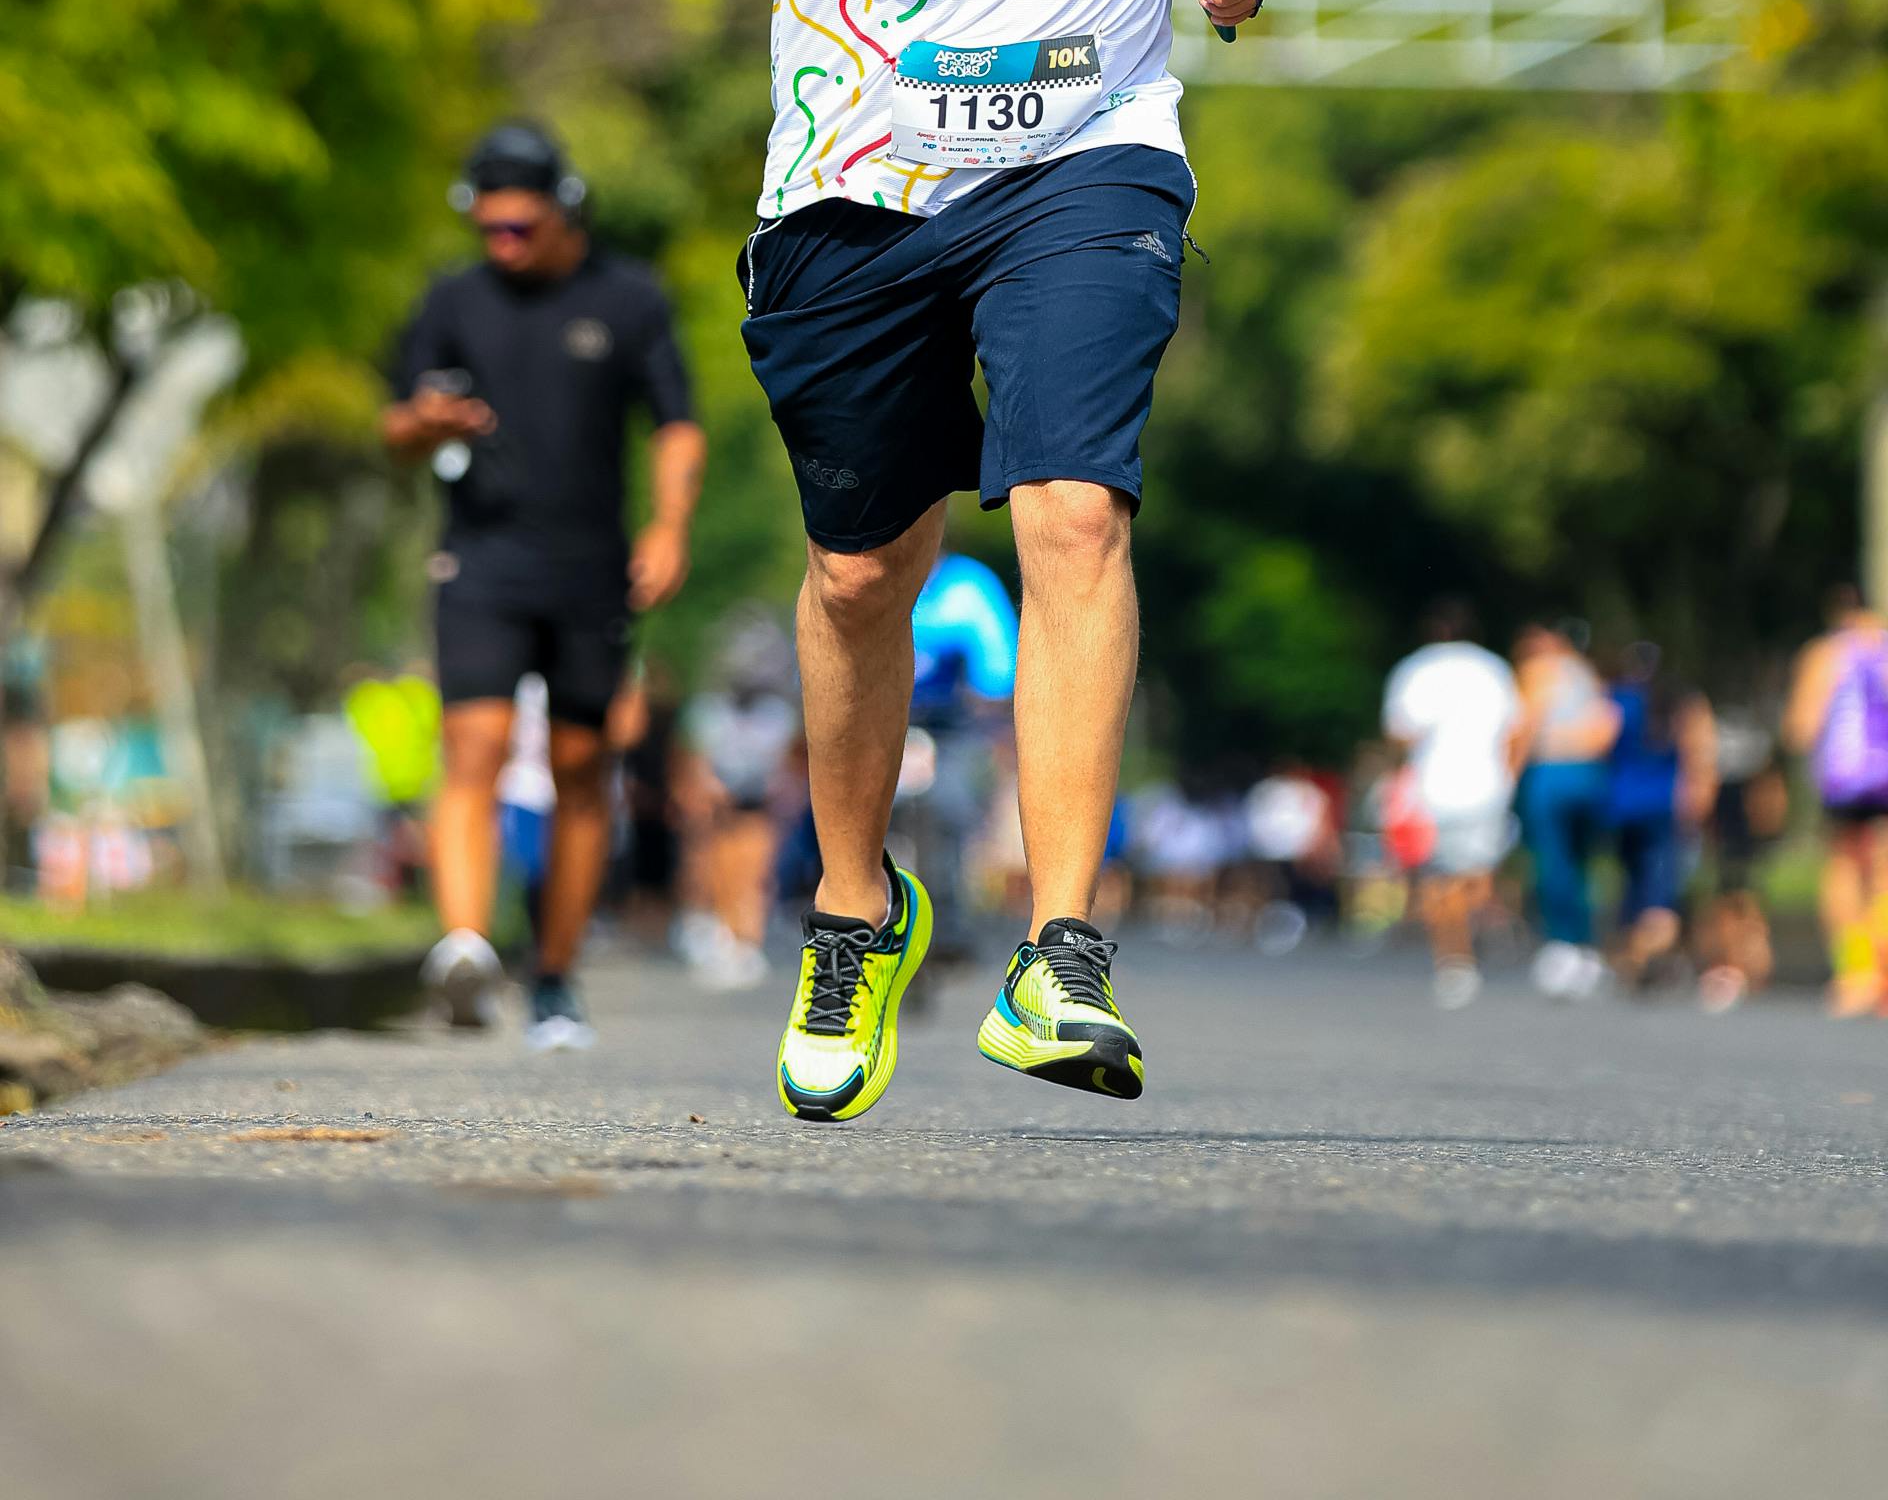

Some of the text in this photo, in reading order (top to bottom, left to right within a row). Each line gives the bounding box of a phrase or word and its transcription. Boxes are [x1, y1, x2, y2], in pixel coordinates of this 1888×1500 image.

[1048, 46, 1091, 69] 10K
[929, 92, 1044, 131] 1130
[1132, 241, 1172, 263] adidas
